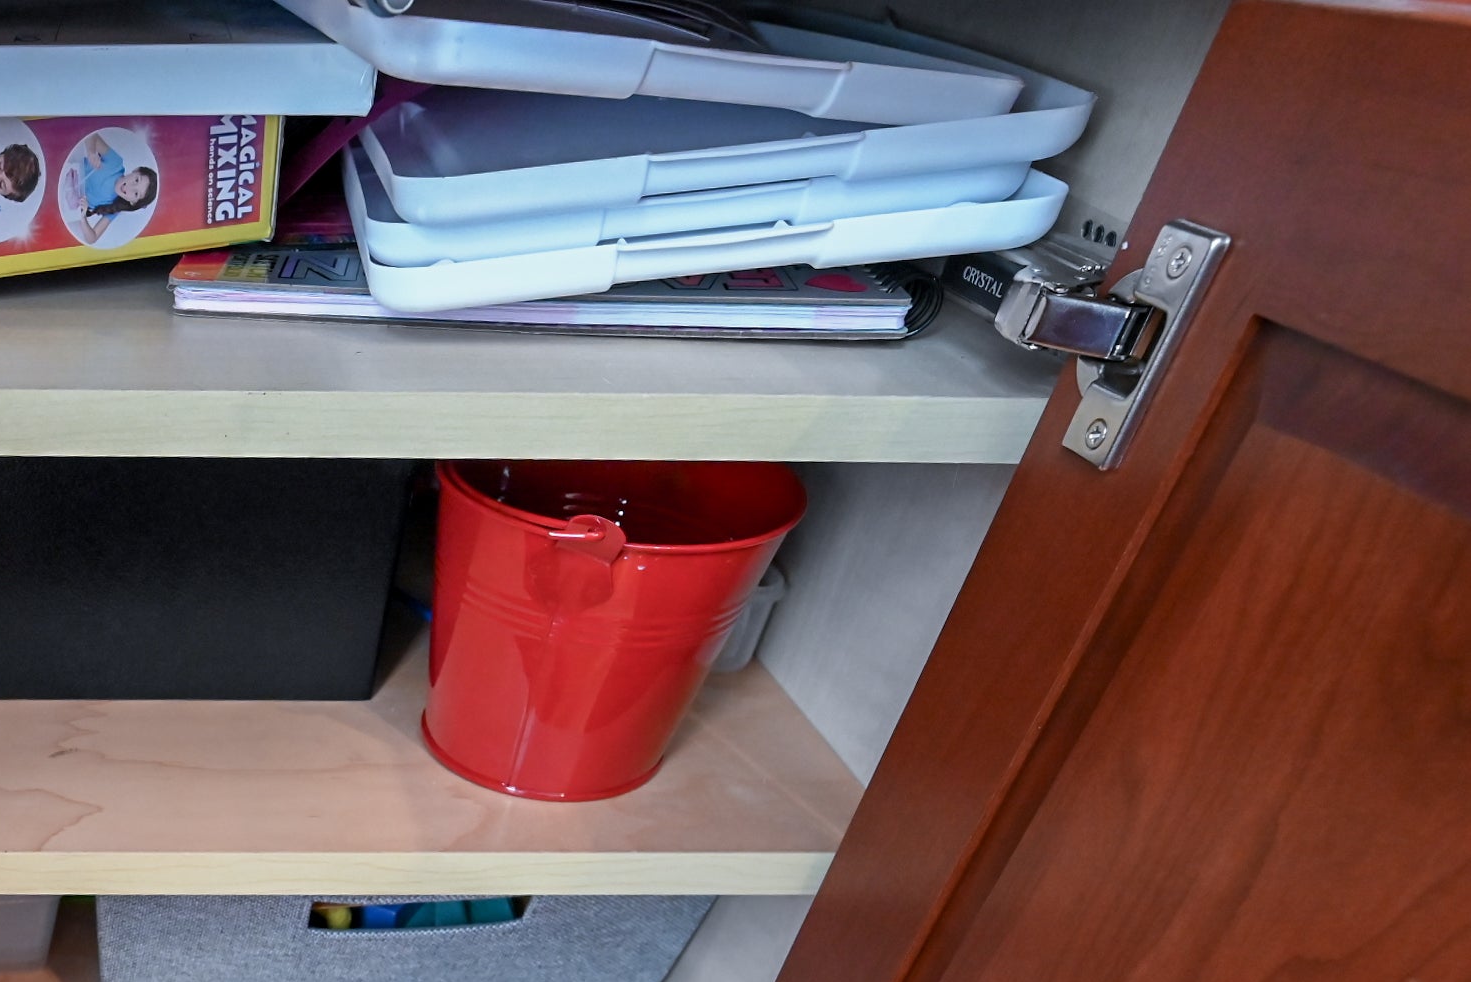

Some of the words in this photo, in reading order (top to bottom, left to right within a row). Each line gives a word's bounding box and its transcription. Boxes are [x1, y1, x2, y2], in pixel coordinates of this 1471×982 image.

[208, 172, 214, 185] on
[210, 115, 238, 221] MIXING
[963, 266, 1003, 298] CRYSTAL
